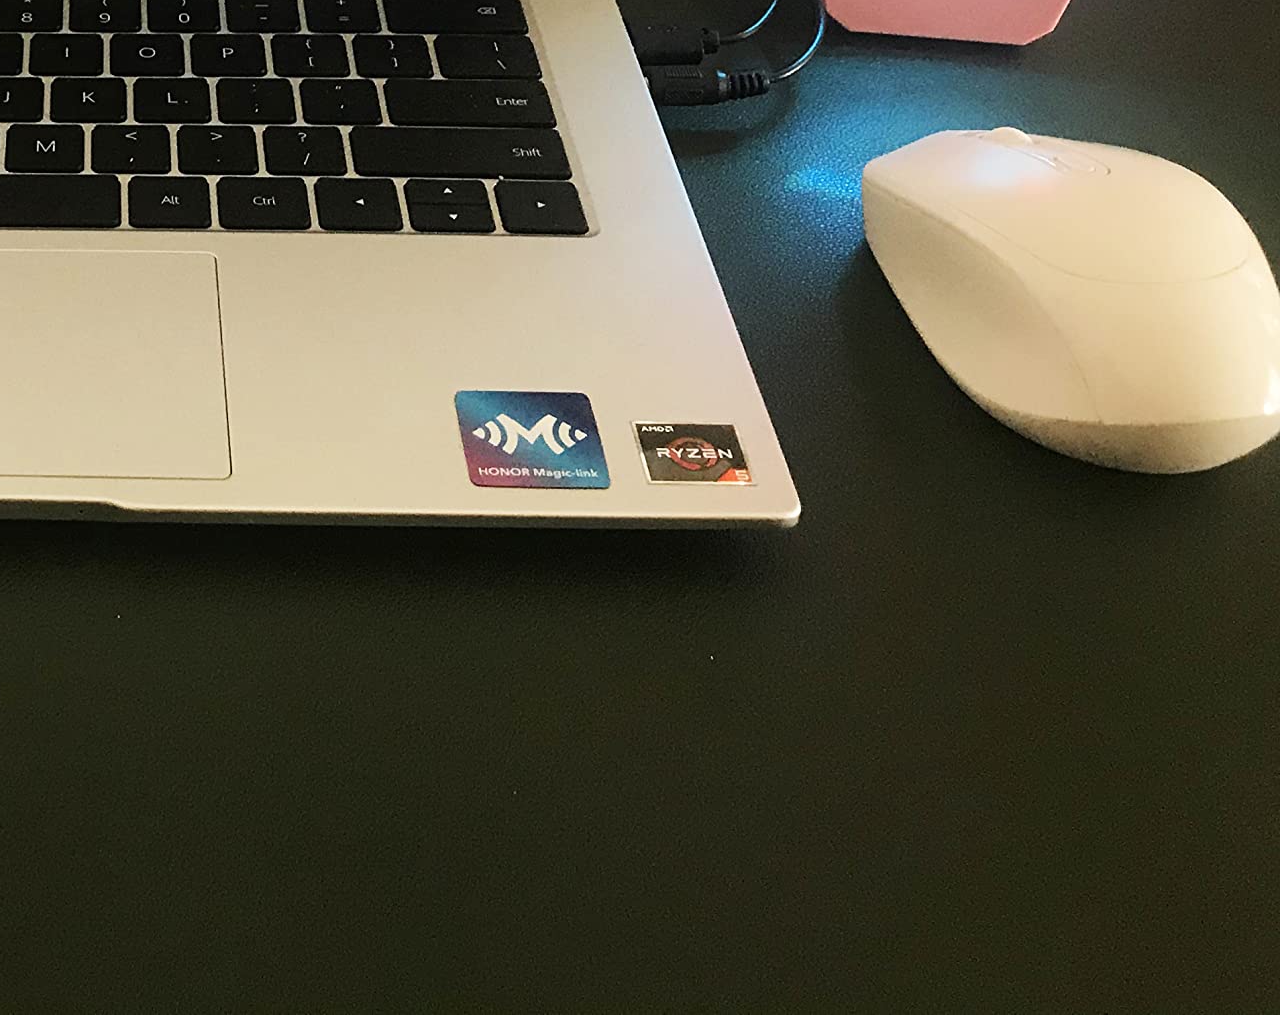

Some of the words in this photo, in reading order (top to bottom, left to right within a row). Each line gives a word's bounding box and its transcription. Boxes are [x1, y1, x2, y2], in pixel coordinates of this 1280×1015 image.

[20, 12, 33, 23] 8
[98, 12, 111, 24] 9
[178, 12, 190, 24] 0
[138, 47, 156, 59] O
[222, 47, 234, 59] P
[3, 91, 10, 103] J
[82, 91, 96, 103] K
[167, 92, 179, 104] L
[495, 97, 529, 106] Enter
[36, 140, 56, 153] M
[512, 147, 542, 157] Shift
[160, 195, 180, 205] Alt
[252, 196, 276, 206] Ctrl
[655, 447, 734, 459] RYZEN
[478, 466, 531, 477] HONOR
[533, 467, 600, 479] Magic-link
[734, 469, 750, 481] 5
